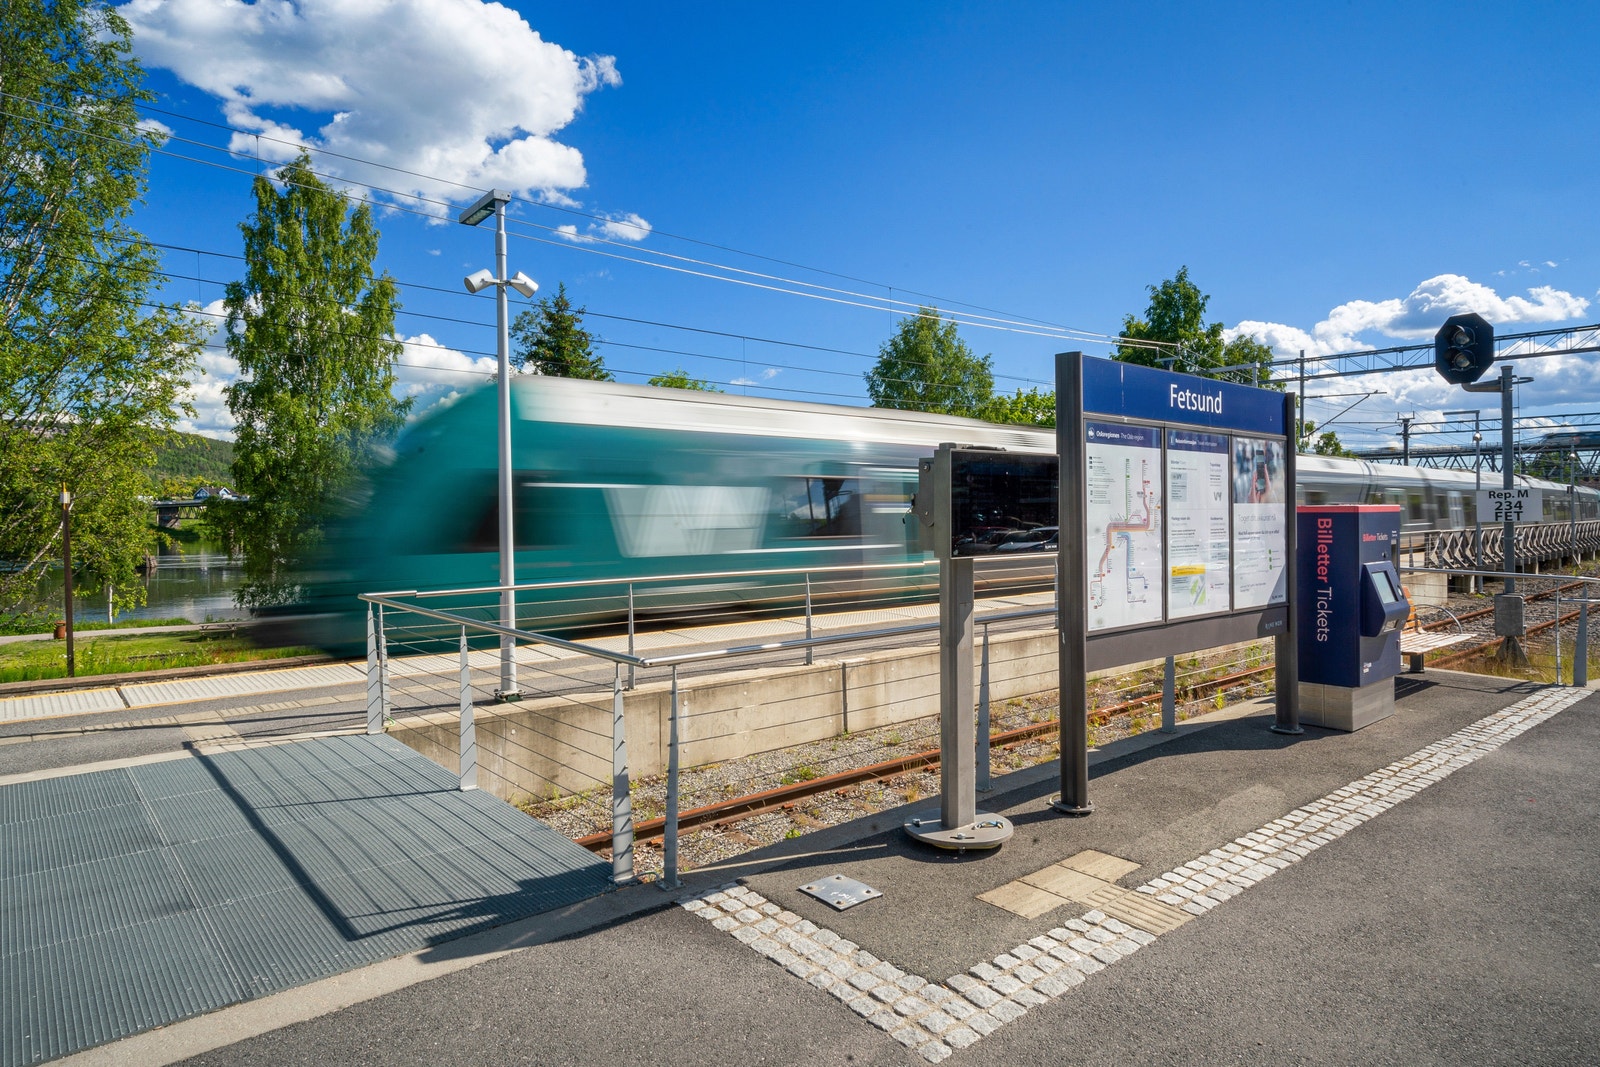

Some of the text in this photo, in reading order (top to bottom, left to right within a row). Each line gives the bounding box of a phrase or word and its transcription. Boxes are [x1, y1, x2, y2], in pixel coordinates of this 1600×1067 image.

[1170, 383, 1222, 414] Fetsund
[1096, 430, 1120, 439] Osloregionen
[1134, 434, 1144, 442] region
[1488, 489, 1529, 500] Rep. M
[1494, 500, 1523, 511] 234
[1494, 511, 1523, 521] FET
[1317, 518, 1333, 642] Billetter Tickets
